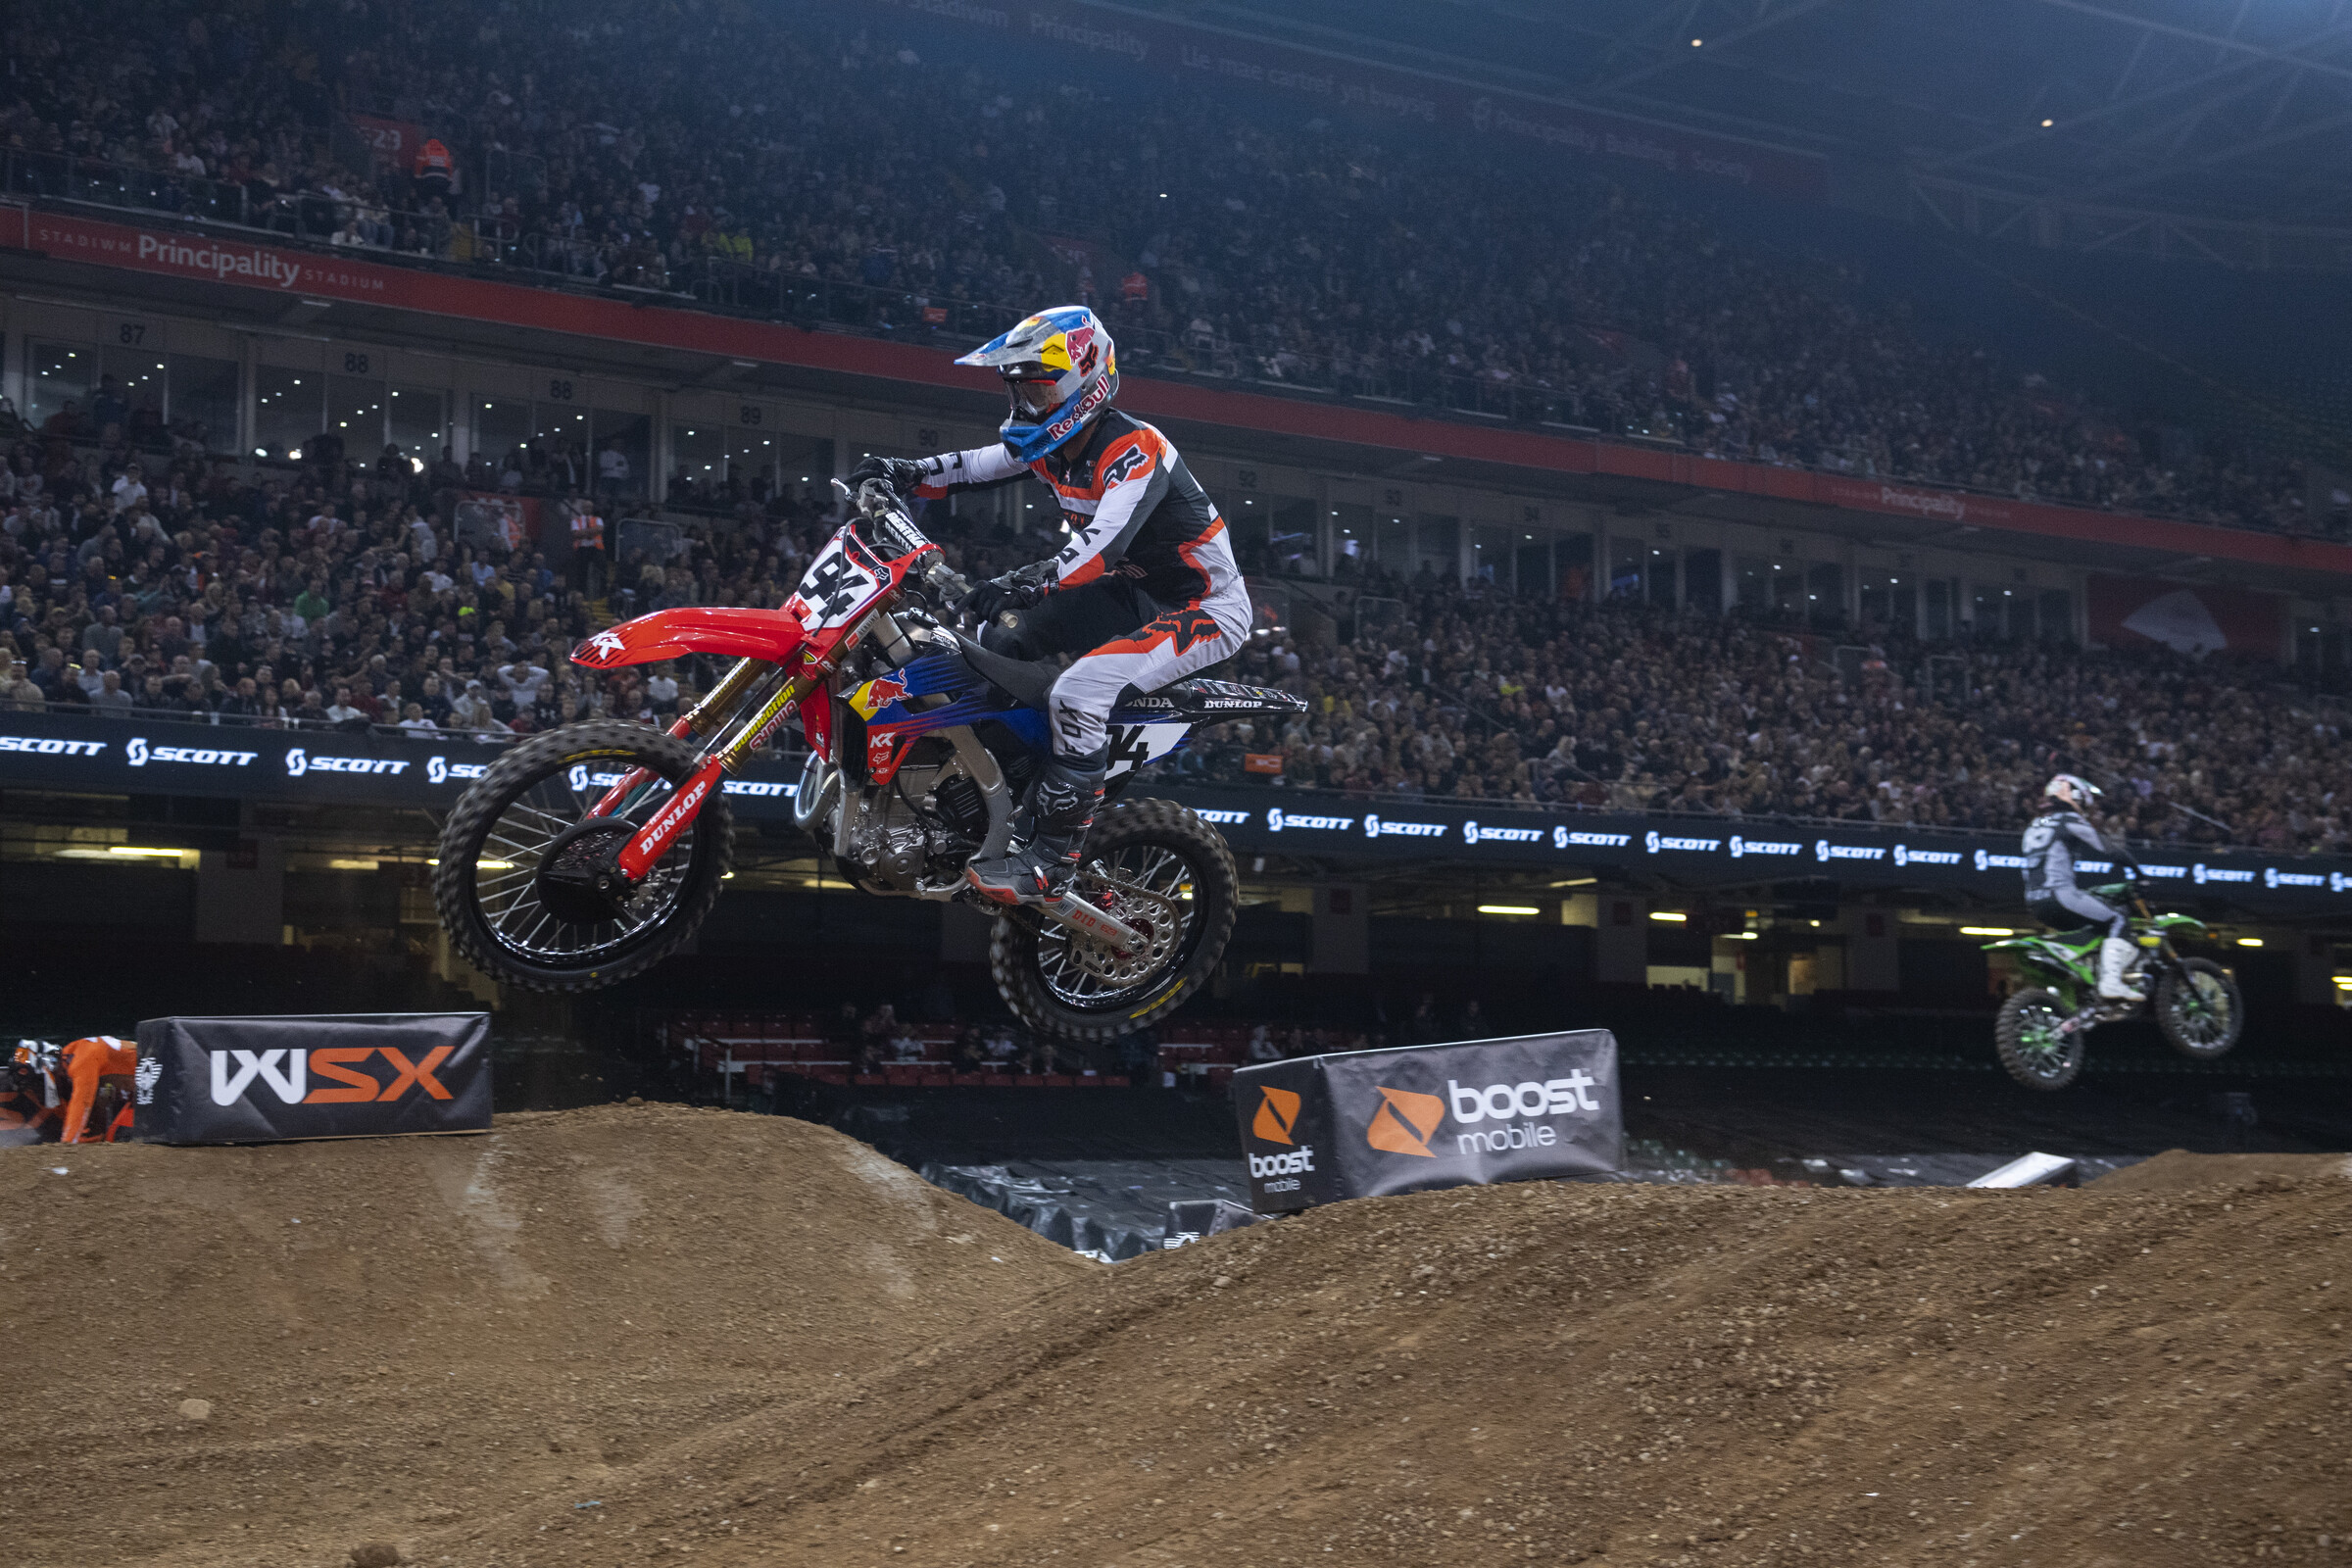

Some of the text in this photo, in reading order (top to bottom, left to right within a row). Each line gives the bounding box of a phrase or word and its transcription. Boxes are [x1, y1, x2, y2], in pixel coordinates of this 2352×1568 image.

[39, 228, 384, 290] STADIWM Principality STADIUM
[120, 323, 146, 345] 87
[345, 353, 369, 374] 88
[551, 380, 574, 401] 88
[739, 405, 762, 425] 89
[799, 552, 869, 619] 94
[1125, 697, 1175, 708] NDA
[1203, 700, 1263, 709] DUNLOP
[750, 700, 798, 751] SHOWA
[0, 737, 108, 756] SCOTT
[150, 747, 259, 765] SCOTT
[308, 758, 412, 774] SCOTT
[722, 780, 799, 797] SCOTT
[639, 780, 707, 856] DUNLOP
[1196, 808, 1250, 823] COTT
[1284, 814, 1355, 830] SCOTT
[1380, 821, 1448, 837] SCOTT
[1479, 827, 1545, 842] SCOTT
[1568, 832, 1633, 847] SCOTT
[1660, 837, 1722, 852] SCOTT
[1742, 841, 1804, 856] SCOTT
[1830, 846, 1887, 860] SCOTT
[1906, 850, 1964, 864] SCOTT
[1987, 855, 2027, 868] SCO
[2074, 860, 2115, 873] COTT
[2137, 864, 2188, 878] SCOTT
[2205, 868, 2255, 882] SCOTT
[2277, 872, 2327, 886] SCOTT
[1071, 909, 1097, 927] DID
[1447, 1068, 1599, 1125] boost
[1457, 1121, 1557, 1155] mobile
[1249, 1145, 1315, 1178] boost
[1263, 1177, 1301, 1194] mobile
